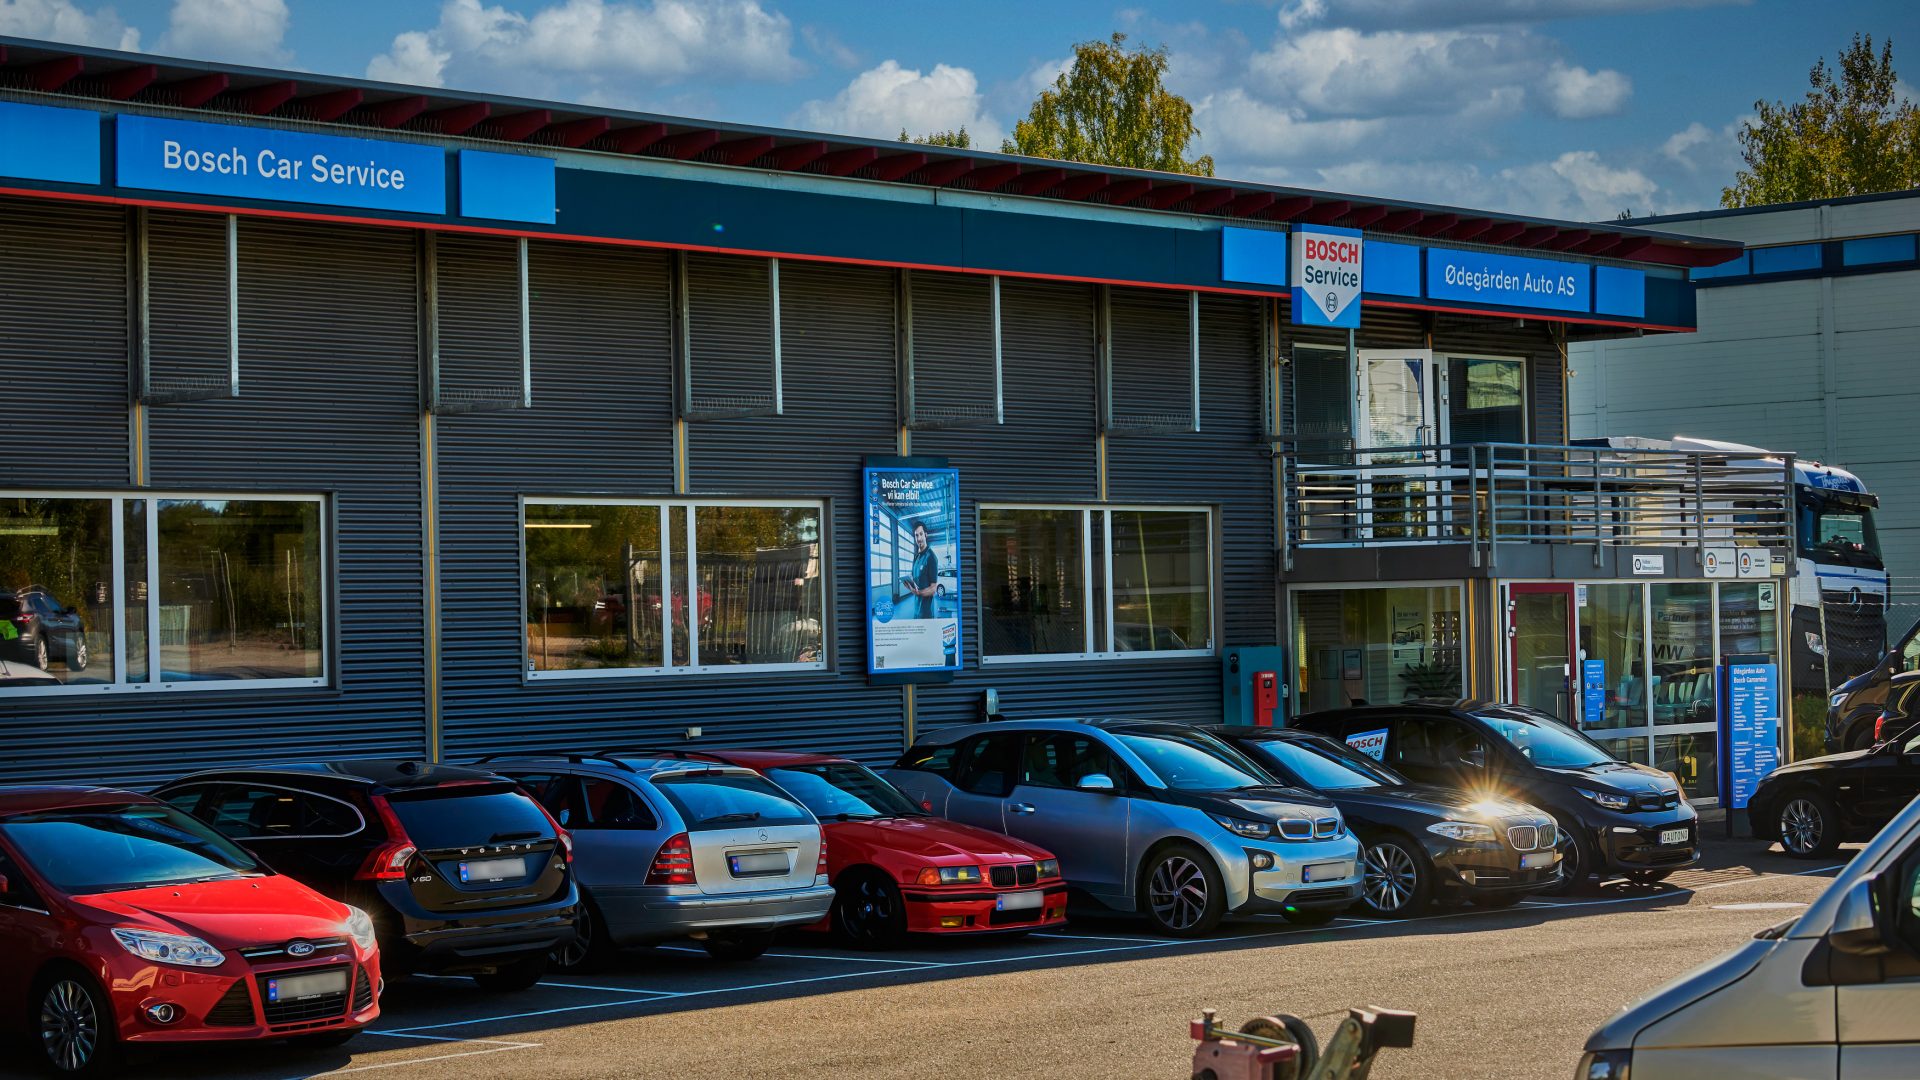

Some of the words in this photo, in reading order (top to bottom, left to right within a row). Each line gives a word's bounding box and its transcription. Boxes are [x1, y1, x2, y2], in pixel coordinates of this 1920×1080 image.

[163, 140, 248, 176] Bosch
[257, 149, 303, 181] Car
[310, 155, 405, 190] Service
[1305, 239, 1359, 265] BOSCH
[1304, 264, 1359, 288] Service
[1444, 264, 1520, 293] Ødegården
[1523, 272, 1554, 295] Auto
[1556, 275, 1576, 296] AS
[881, 478, 900, 489] Bosch
[900, 479, 910, 489] Car
[911, 479, 933, 489] Service
[887, 490, 893, 500] vi
[894, 490, 905, 500] kan
[905, 490, 920, 500] elbil!
[461, 844, 532, 855] VOLVO
[412, 875, 431, 883] V60
[294, 943, 309, 953] Ford
